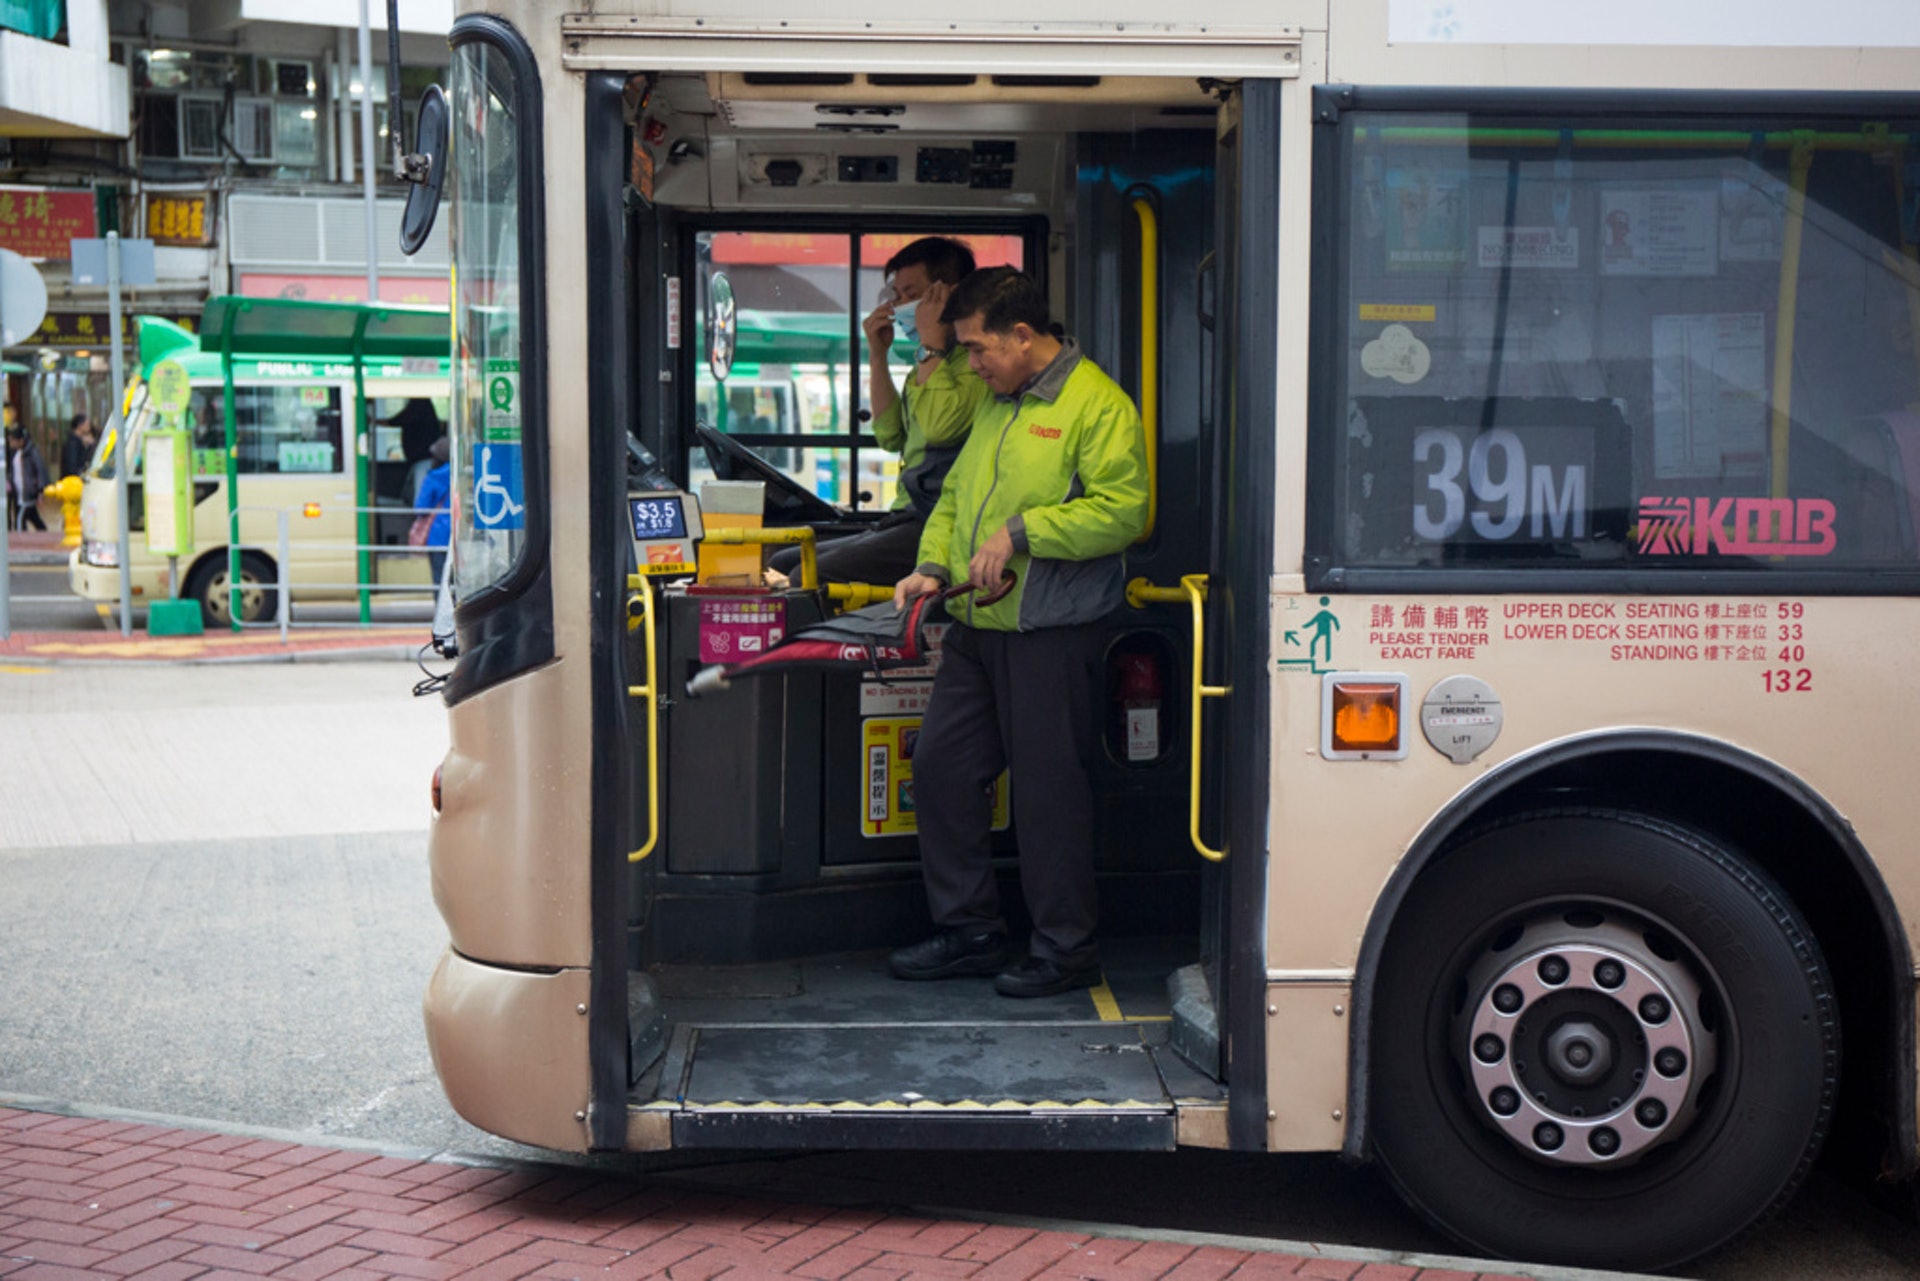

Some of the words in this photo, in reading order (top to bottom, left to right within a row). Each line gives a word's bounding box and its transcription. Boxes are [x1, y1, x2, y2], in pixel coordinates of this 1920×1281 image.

[1412, 429, 1587, 541] 39M
[636, 502, 676, 520] $3.5
[1698, 496, 1838, 557] KMB
[1369, 603, 1489, 629] 請備輔幣
[1503, 602, 1563, 619] UPPER
[1568, 602, 1617, 619] DECK
[1625, 602, 1700, 619] SEATING
[1704, 603, 1768, 619] 樓上座位
[1777, 601, 1804, 620] 59
[1369, 632, 1425, 645] PLEASE
[1429, 632, 1489, 645] TENDER
[1504, 623, 1567, 640] LOWER
[1572, 623, 1621, 640] DECK
[1625, 623, 1699, 640] SEATING
[1704, 624, 1767, 640] 樓下座位
[1778, 623, 1803, 641] 33
[1380, 646, 1434, 659] EXACT
[1437, 646, 1477, 659] FARE
[1610, 644, 1699, 661] STANDING
[1703, 644, 1767, 661] 樓下企位
[1778, 644, 1805, 662] 40
[1761, 667, 1813, 693] 132
[866, 687, 878, 696] NO
[880, 687, 918, 696] STANDING
[1441, 706, 1486, 715] EMERGENCY
[1452, 734, 1471, 744] LIFT
